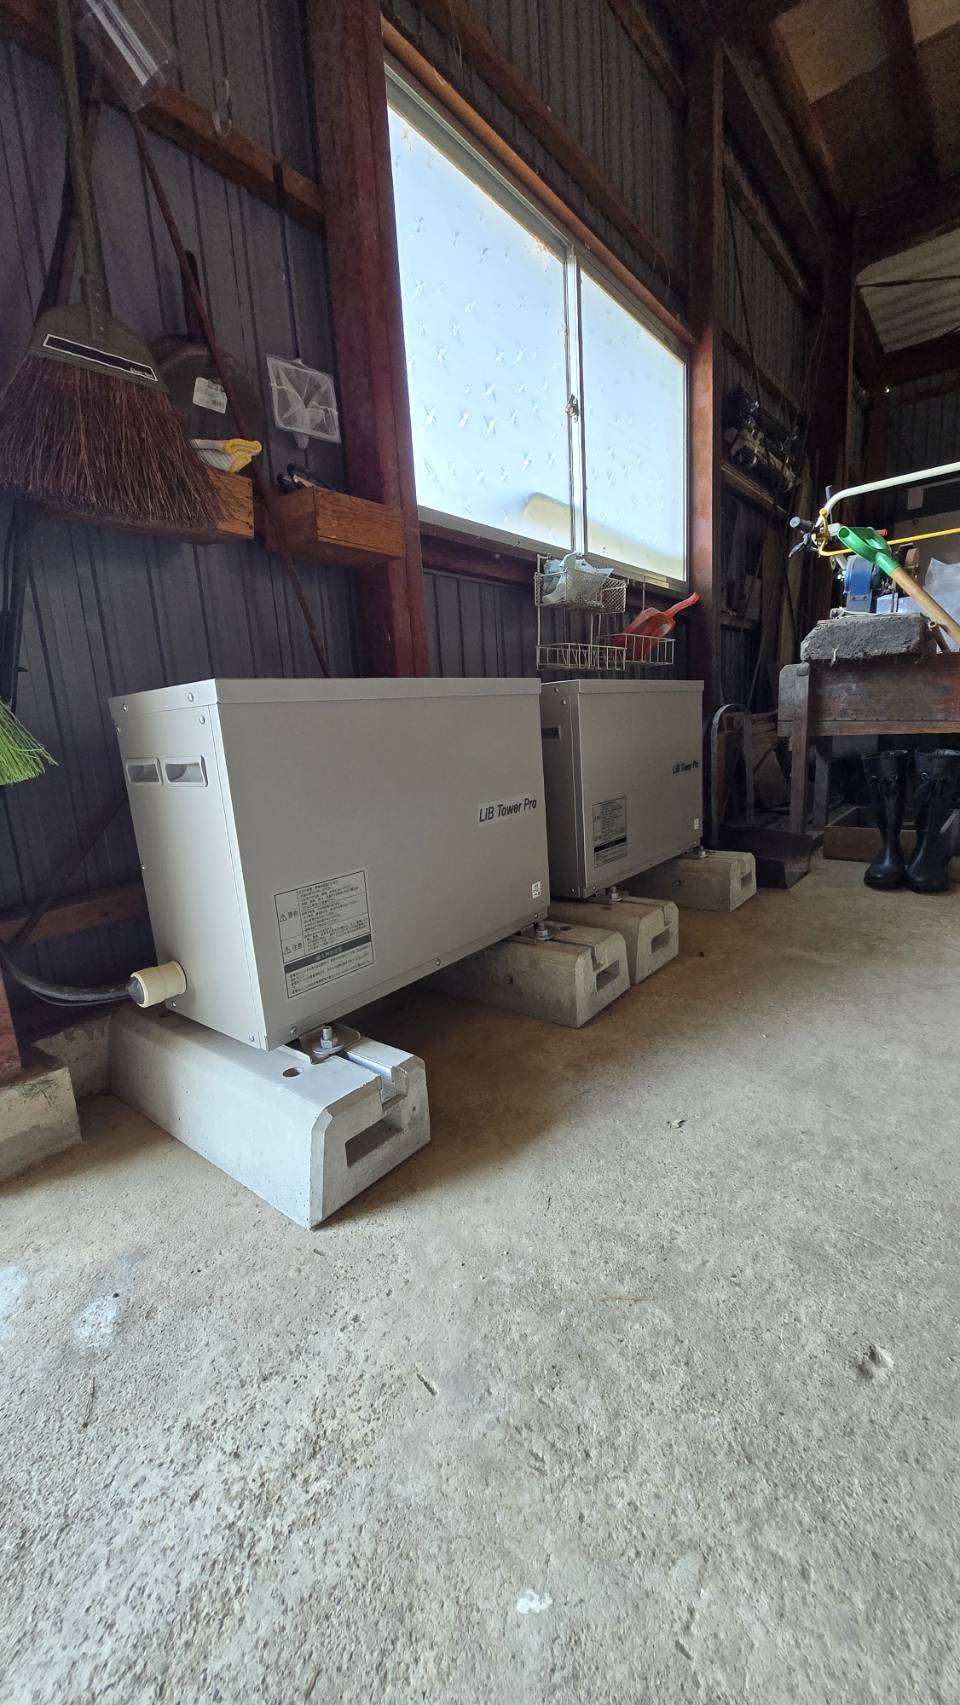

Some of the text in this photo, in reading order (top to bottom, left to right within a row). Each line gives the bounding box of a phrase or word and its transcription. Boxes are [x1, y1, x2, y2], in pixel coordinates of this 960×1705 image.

[479, 797, 537, 822] LIB Tower Pro
